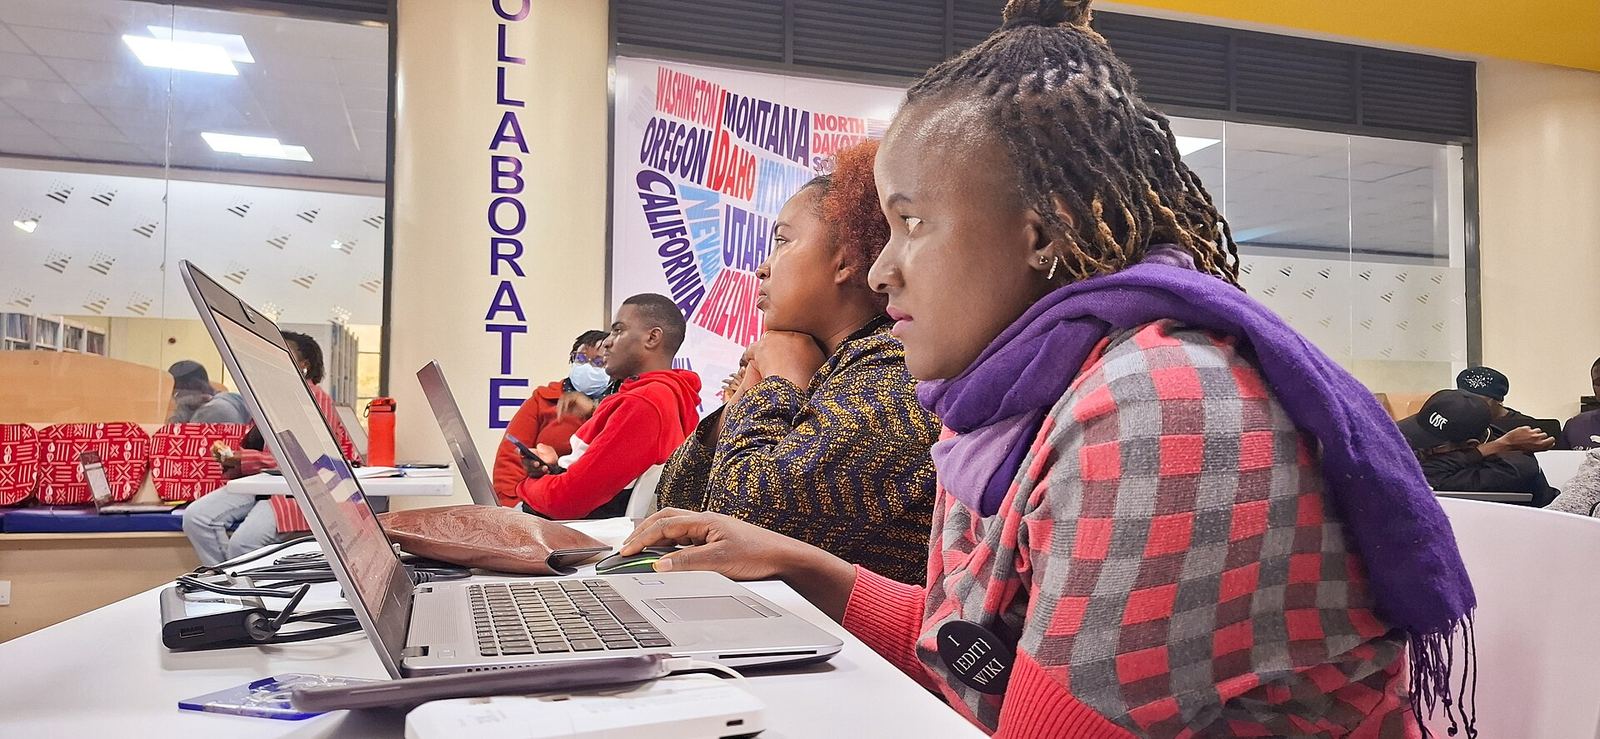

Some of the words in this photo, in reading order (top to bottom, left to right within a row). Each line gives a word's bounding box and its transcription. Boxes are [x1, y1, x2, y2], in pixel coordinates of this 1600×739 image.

[656, 66, 720, 129] WASHINGTON
[723, 92, 810, 168] MONTANA
[814, 113, 865, 134] NORTH
[640, 116, 712, 185] OREGON
[706, 89, 757, 202] IDAHO
[636, 170, 706, 322] CALIFORNIA
[723, 204, 768, 272] UTAH
[693, 269, 760, 348] ARIZONA
[948, 635, 960, 647] I
[972, 658, 1005, 685] WIKI
